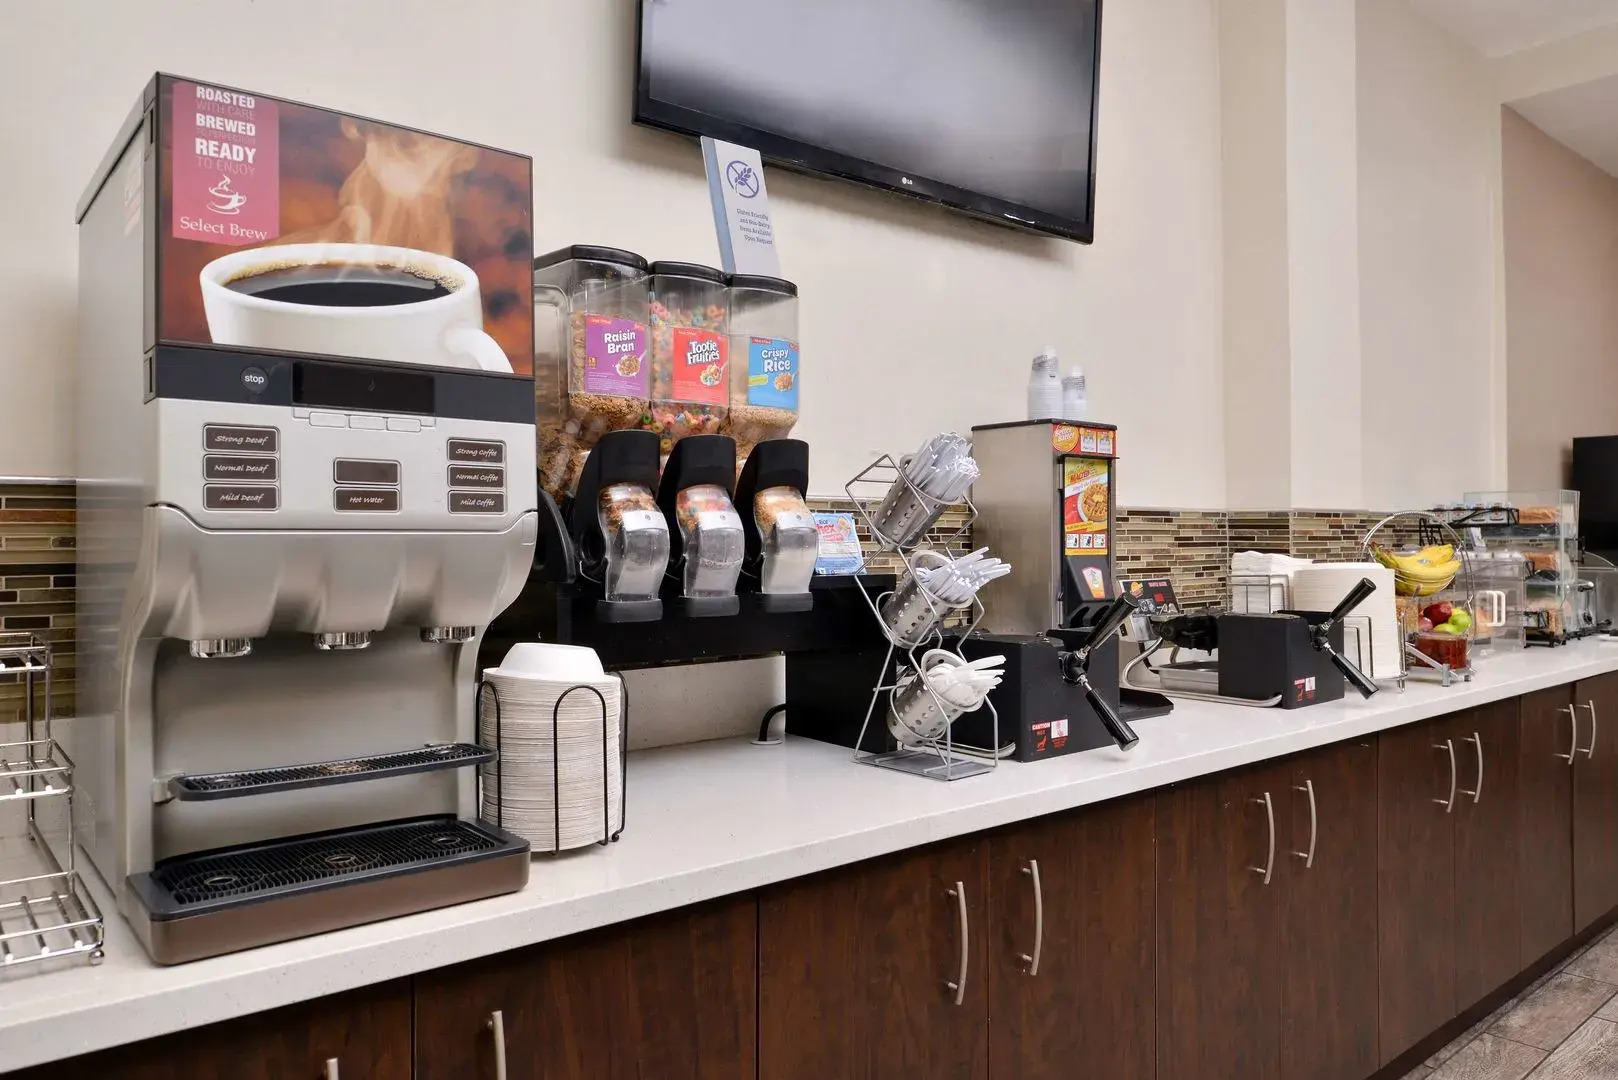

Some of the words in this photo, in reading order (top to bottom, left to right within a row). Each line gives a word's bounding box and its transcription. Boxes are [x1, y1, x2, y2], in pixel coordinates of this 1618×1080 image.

[196, 86, 255, 109] ROASTED
[196, 112, 256, 136] BREWED
[195, 137, 256, 164] READY
[197, 156, 212, 169] TO
[216, 160, 256, 176] ENJOY
[180, 216, 225, 234] Select
[229, 223, 268, 240] Brew
[604, 329, 636, 343] Raisin
[607, 342, 635, 354] Bran
[689, 339, 717, 354] Tootie
[687, 350, 720, 365] Fruities
[761, 348, 789, 360] Crispy
[764, 356, 791, 373] Rice
[245, 374, 264, 384] stop
[214, 435, 244, 445] Strong
[245, 436, 269, 445] Decaf
[455, 448, 478, 457] Strong
[479, 448, 497, 457] Coffee
[245, 464, 269, 474] Decaf
[480, 474, 499, 482] Coffee
[219, 492, 241, 501] Mild
[241, 493, 265, 503] Decaf
[476, 499, 495, 507] Coffee
